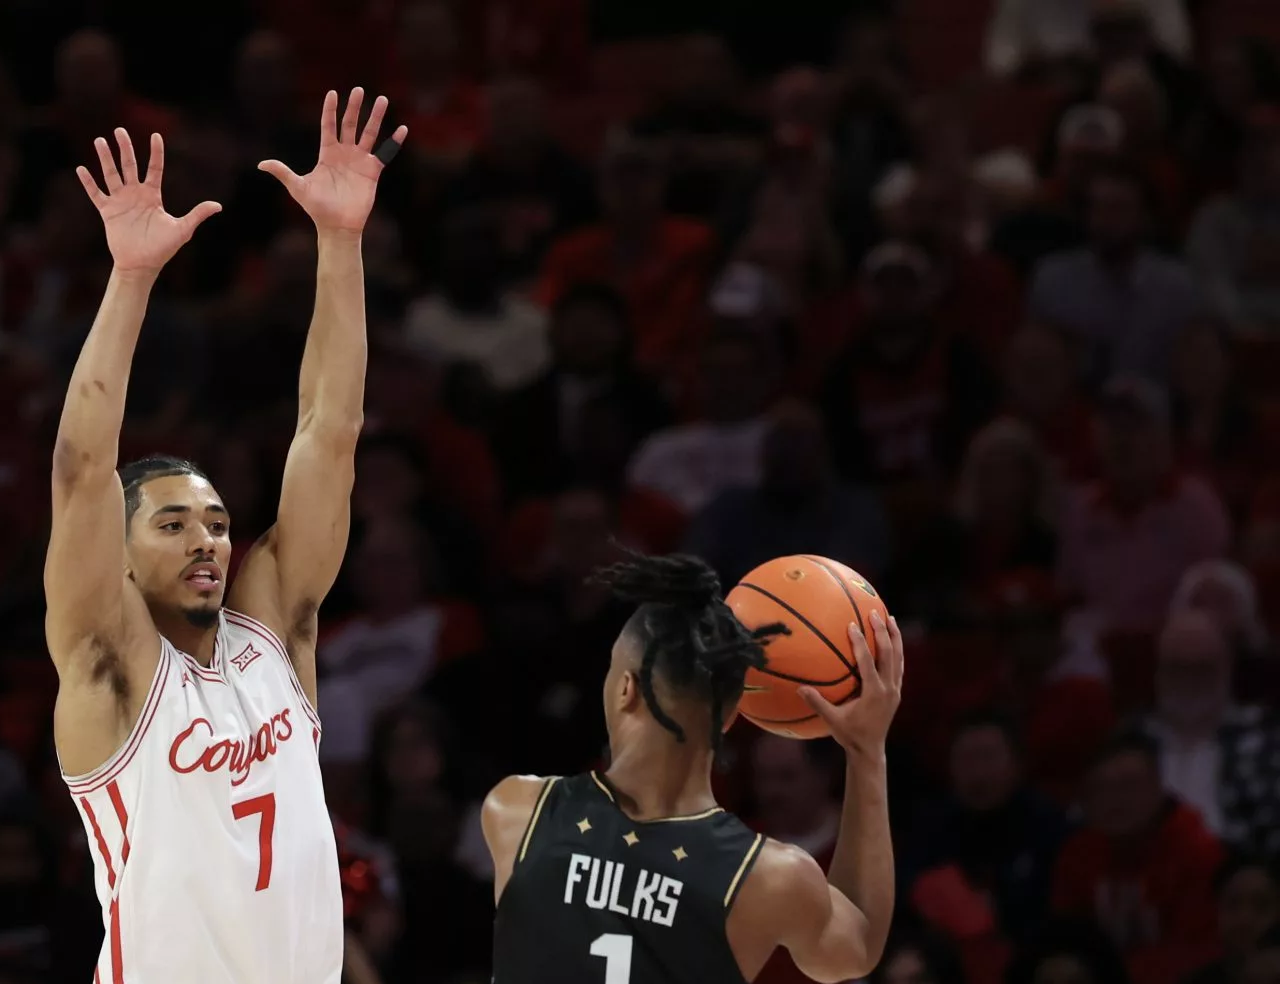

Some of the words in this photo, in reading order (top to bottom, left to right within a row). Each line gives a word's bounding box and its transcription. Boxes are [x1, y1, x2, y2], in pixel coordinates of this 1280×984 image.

[168, 707, 293, 787] Cougars
[231, 792, 276, 892] 7
[564, 853, 684, 927] FULKS
